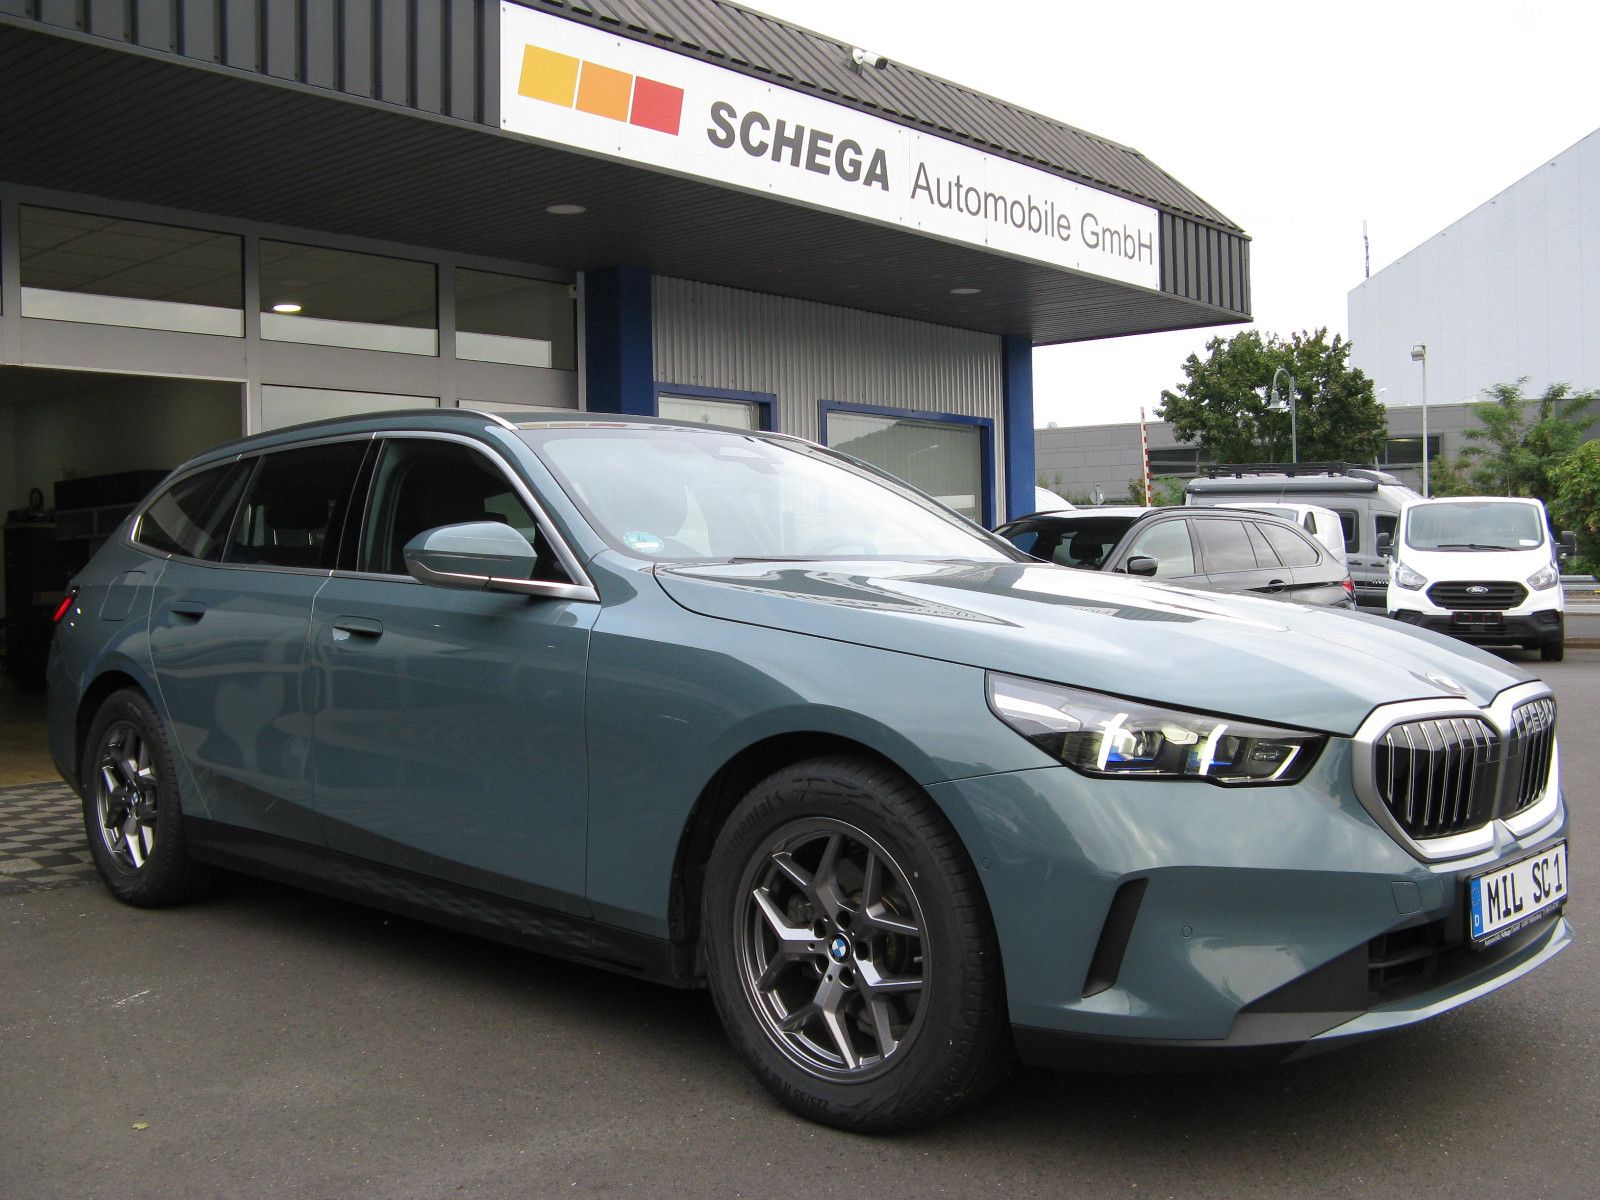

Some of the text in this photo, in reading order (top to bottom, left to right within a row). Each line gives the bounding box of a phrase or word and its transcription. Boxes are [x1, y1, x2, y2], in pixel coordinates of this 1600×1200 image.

[706, 101, 1153, 265] SCHEGA Automobile GmbH
[1474, 914, 1480, 927] D
[1487, 872, 1523, 924] MIL
[1532, 858, 1551, 903] SC
[1553, 853, 1563, 893] 1
